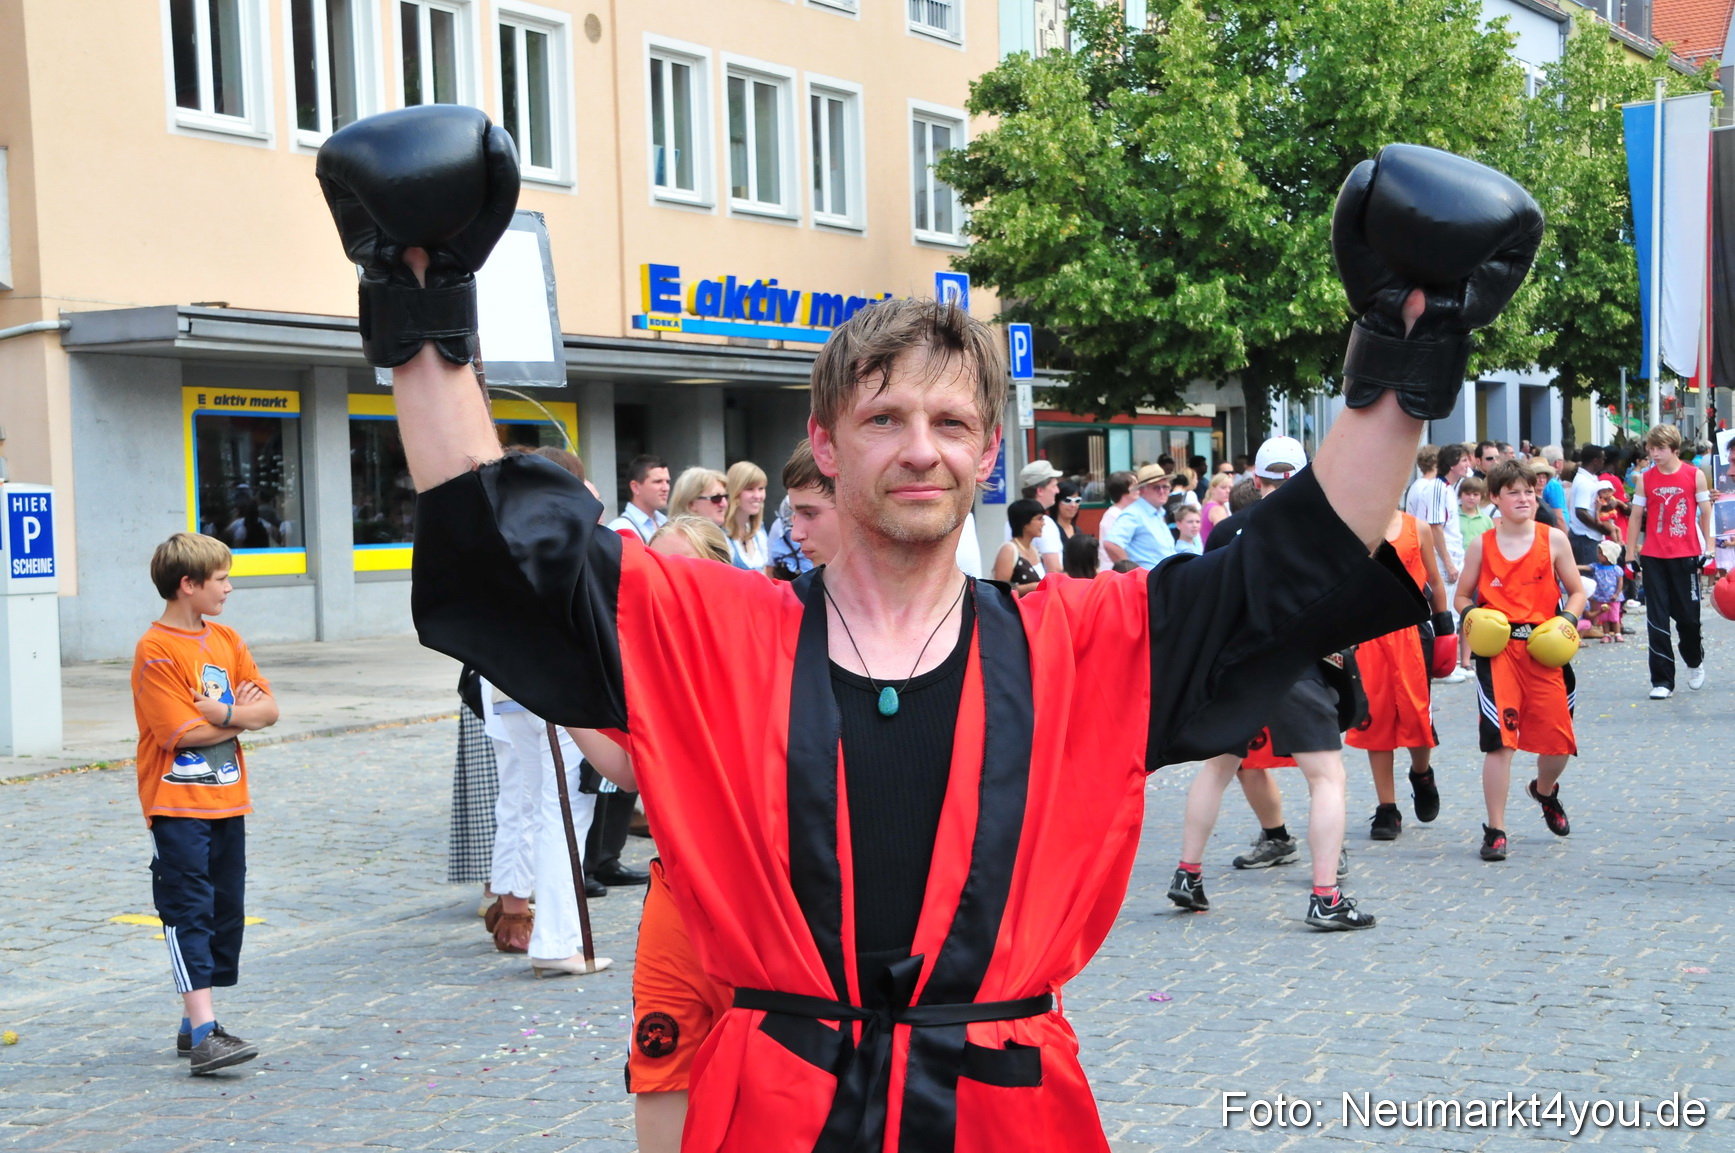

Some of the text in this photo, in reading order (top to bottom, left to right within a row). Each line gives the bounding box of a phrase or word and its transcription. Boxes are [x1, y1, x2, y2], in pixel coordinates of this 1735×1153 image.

[642, 263, 682, 313] E
[688, 275, 801, 323] aktiv
[649, 318, 680, 328] EDEKA
[1014, 331, 1028, 373] P
[197, 394, 288, 408] E aktiv markt
[12, 496, 48, 512] HIER
[22, 516, 42, 554] P
[12, 557, 54, 575] SCHEINE
